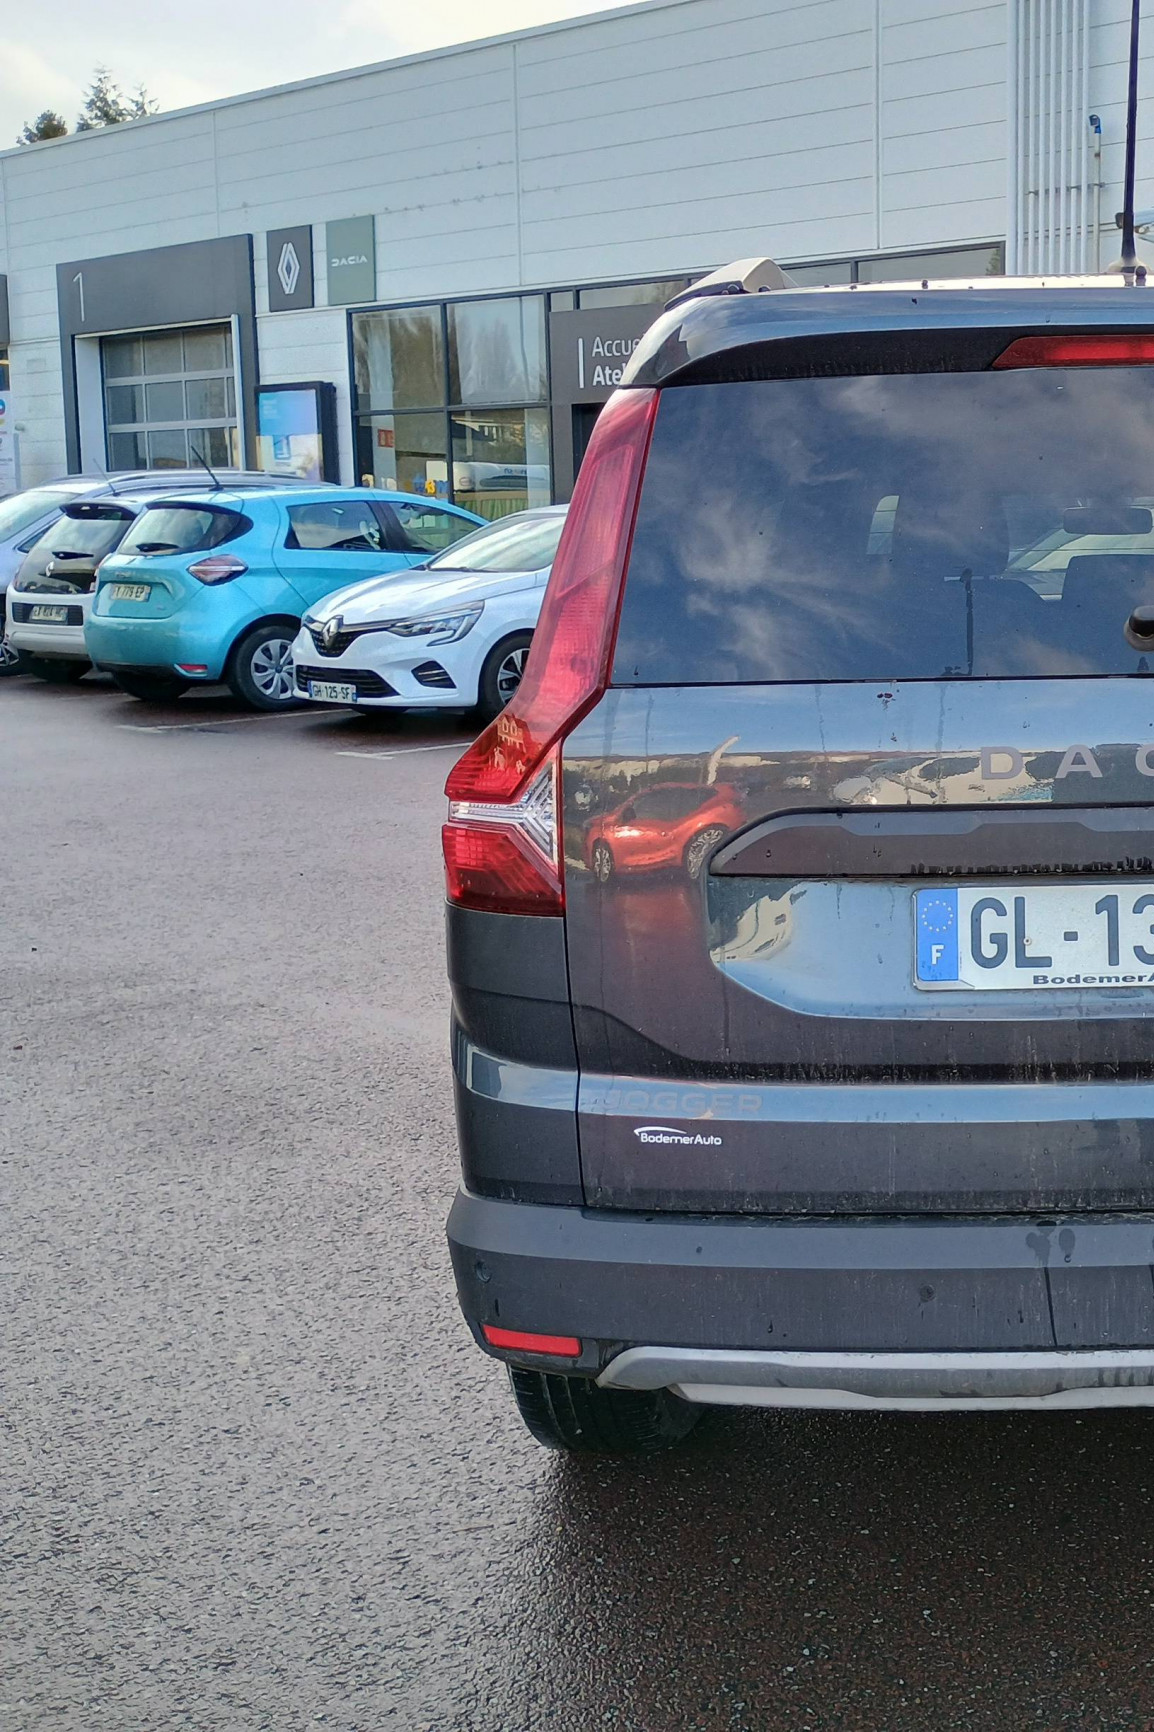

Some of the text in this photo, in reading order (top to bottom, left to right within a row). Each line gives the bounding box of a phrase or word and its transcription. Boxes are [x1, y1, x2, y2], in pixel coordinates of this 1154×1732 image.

[592, 336, 646, 358] Accue
[931, 944, 945, 965] F
[640, 1132, 722, 1146] BodemerAuto
